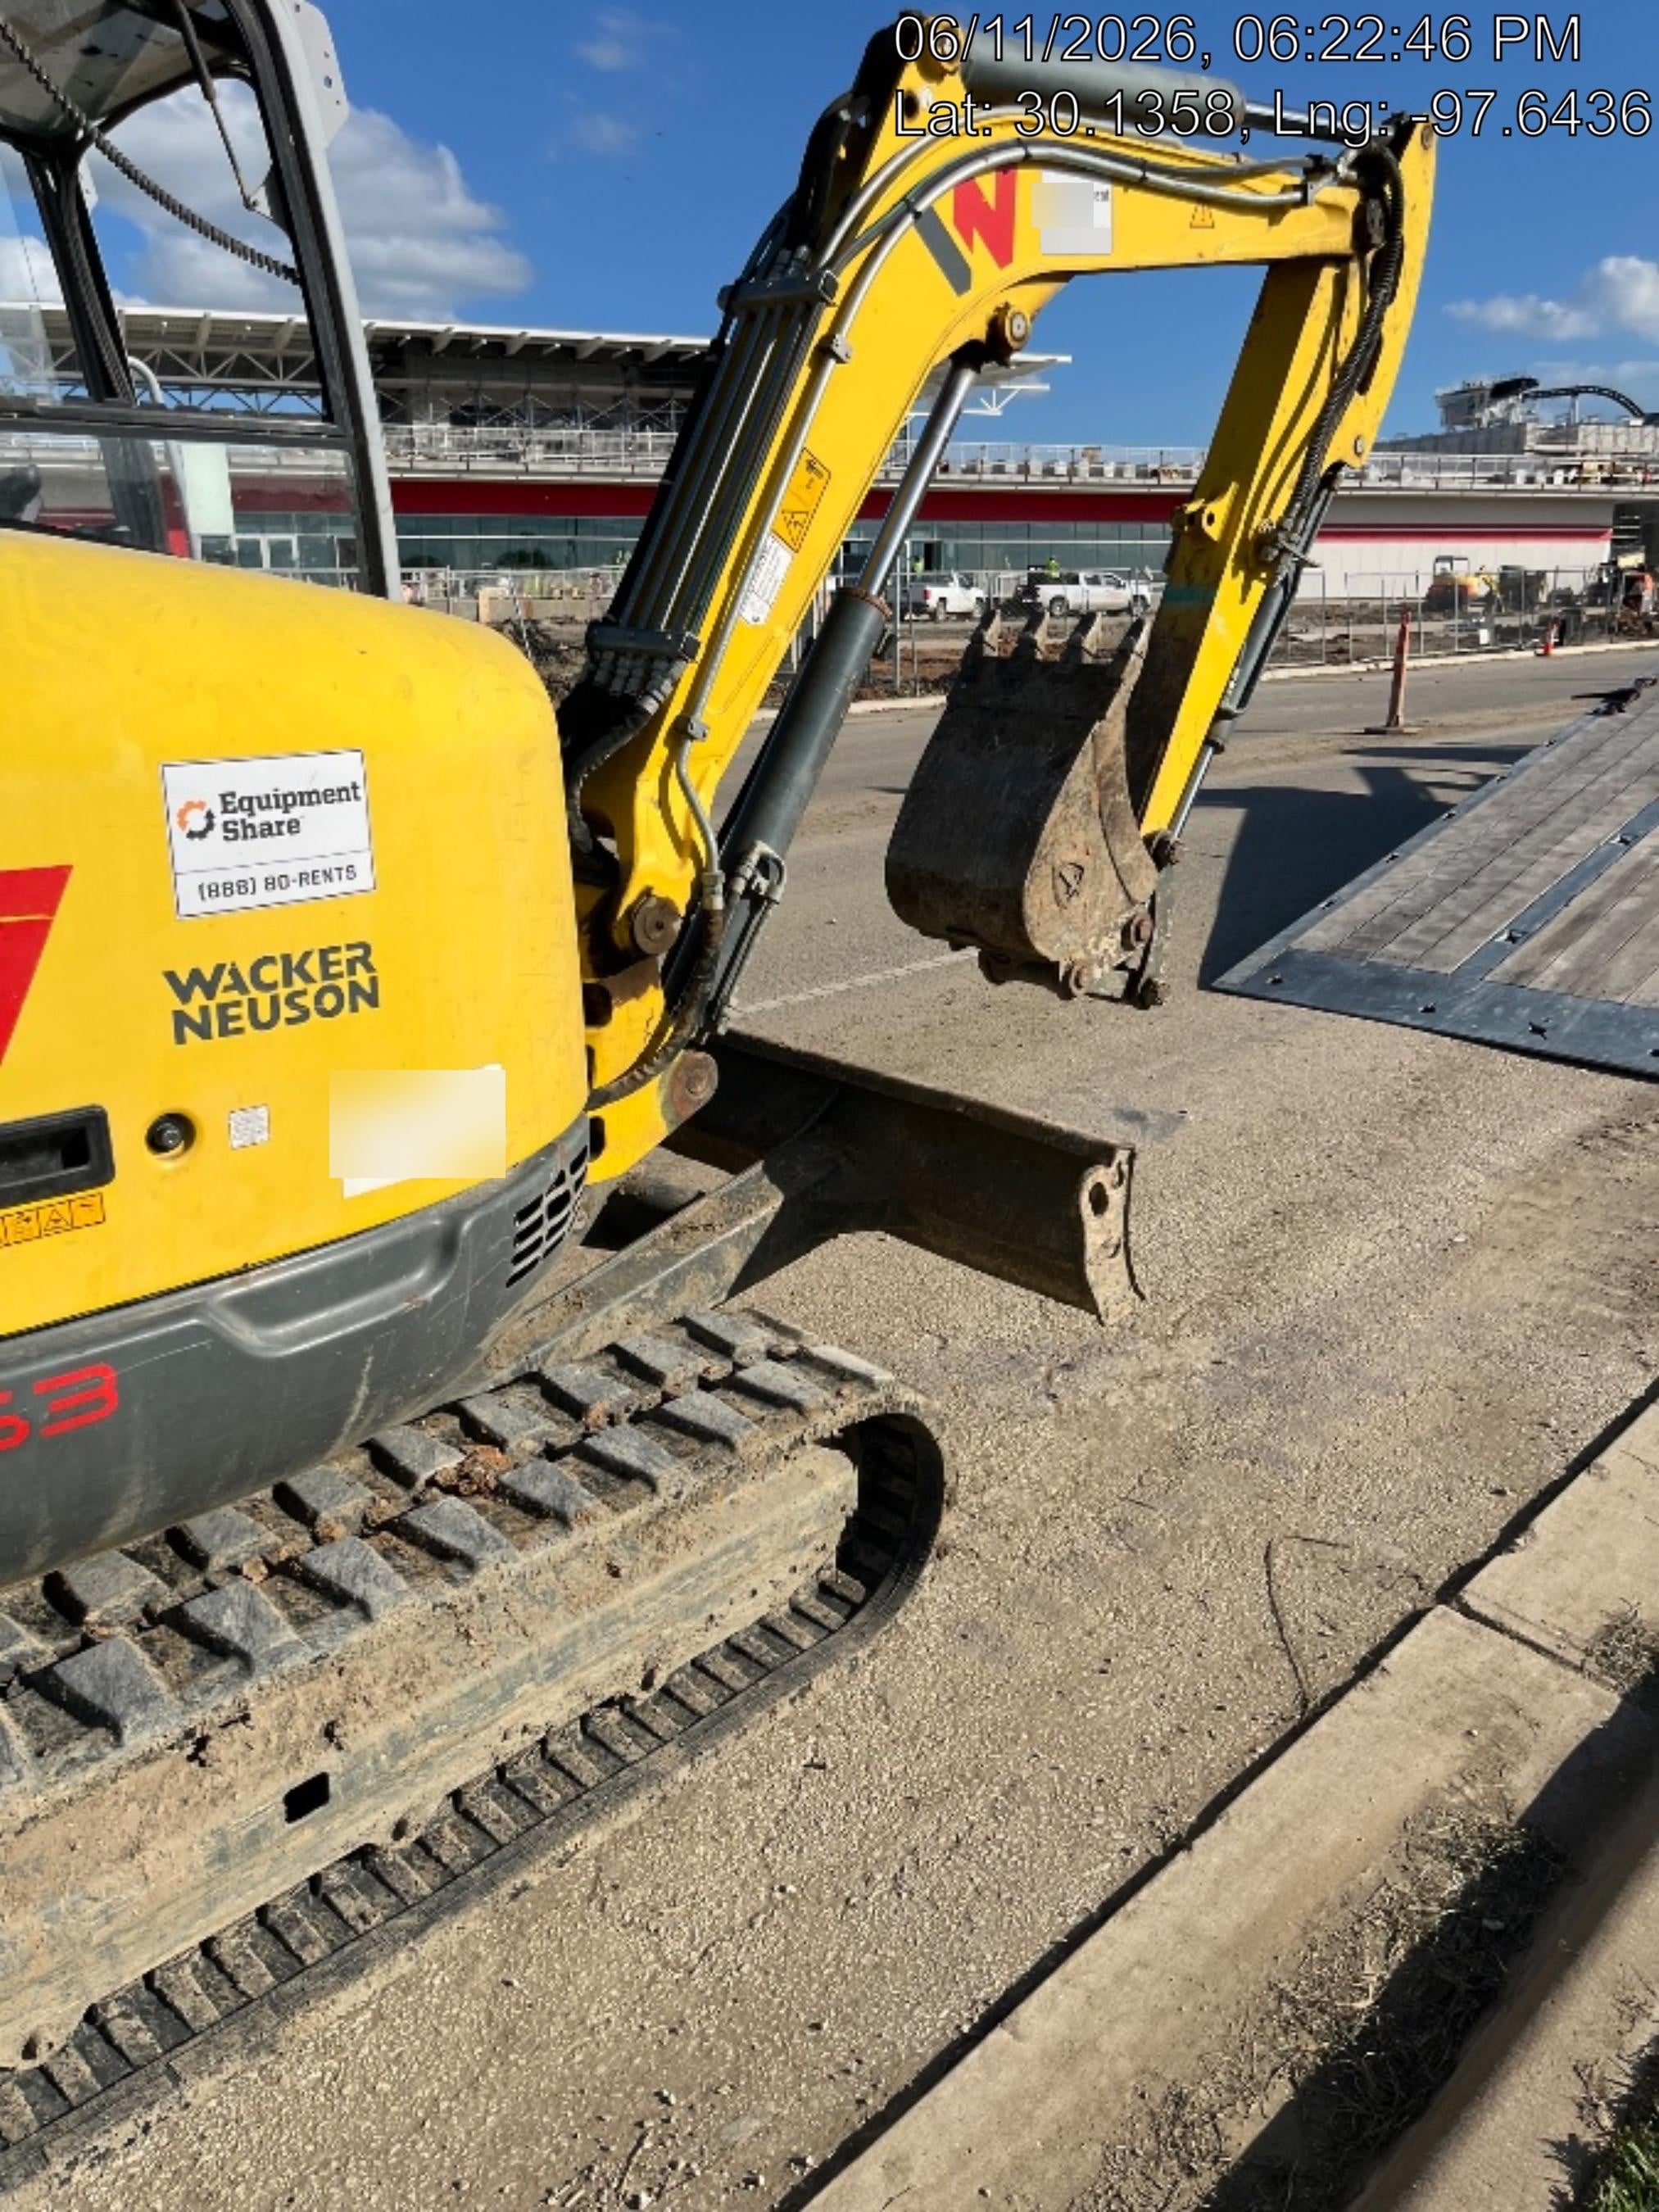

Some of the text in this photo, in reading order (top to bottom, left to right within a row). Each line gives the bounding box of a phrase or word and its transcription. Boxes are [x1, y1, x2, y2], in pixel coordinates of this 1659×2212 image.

[218, 781, 361, 817] Equipment
[221, 817, 301, 841] Share
[197, 864, 357, 902] (888) 80-RENTS
[162, 941, 377, 1005] WACKER
[172, 976, 379, 1045] NEUSON
